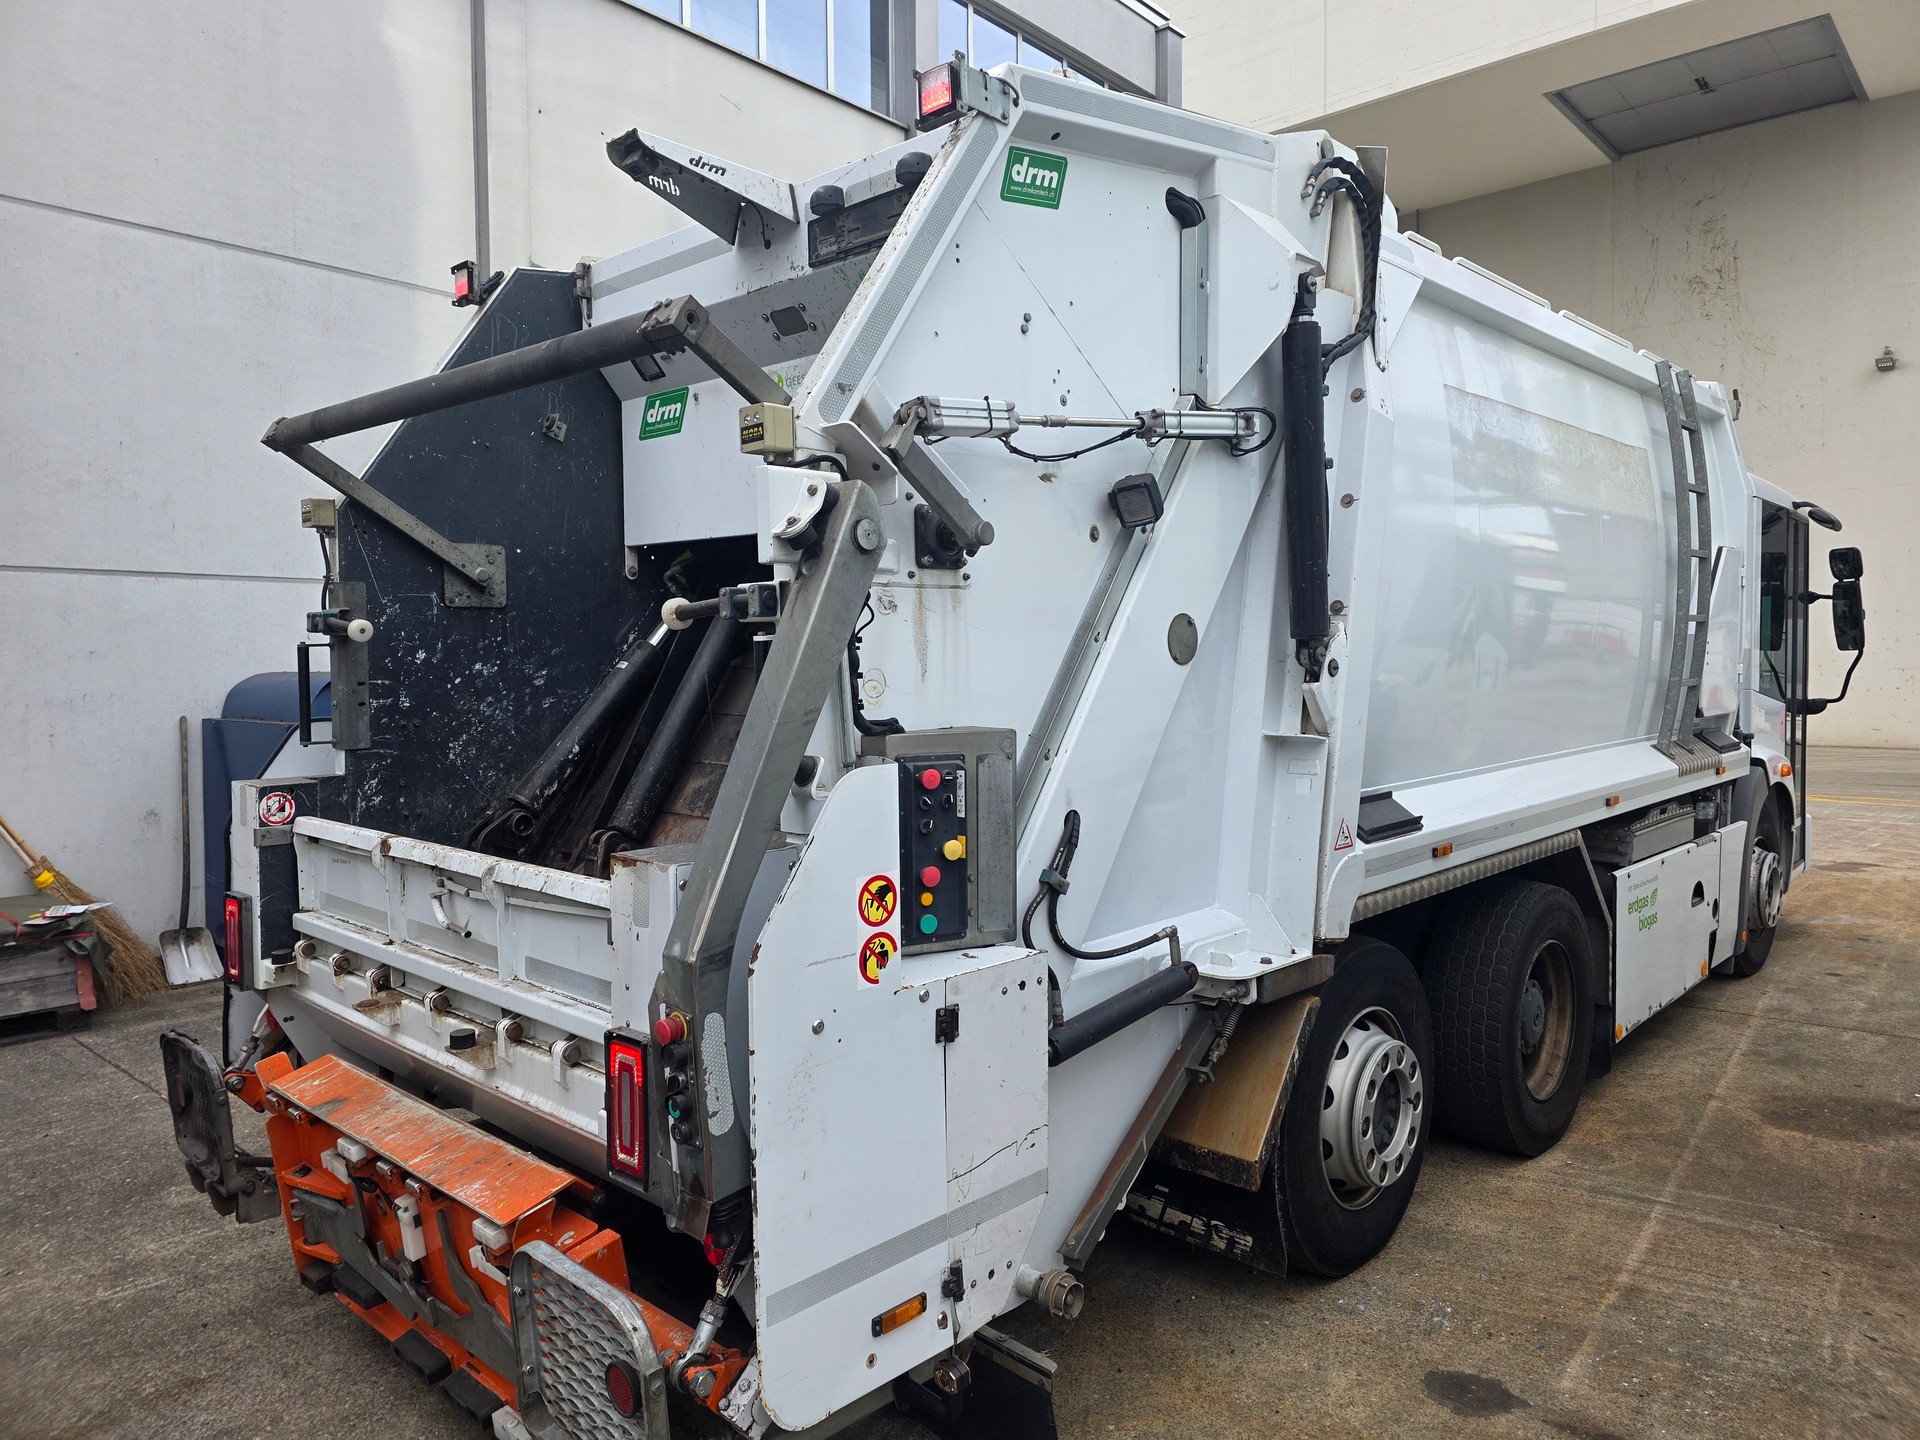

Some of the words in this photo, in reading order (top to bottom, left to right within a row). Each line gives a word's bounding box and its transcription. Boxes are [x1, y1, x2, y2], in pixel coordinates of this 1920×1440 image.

[688, 155, 727, 177] drm
[1011, 156, 1059, 189] drm
[646, 400, 682, 424] drm
[742, 426, 763, 439] MOBA
[1627, 895, 1649, 915] erdgas
[1638, 912, 1658, 932] biogas
